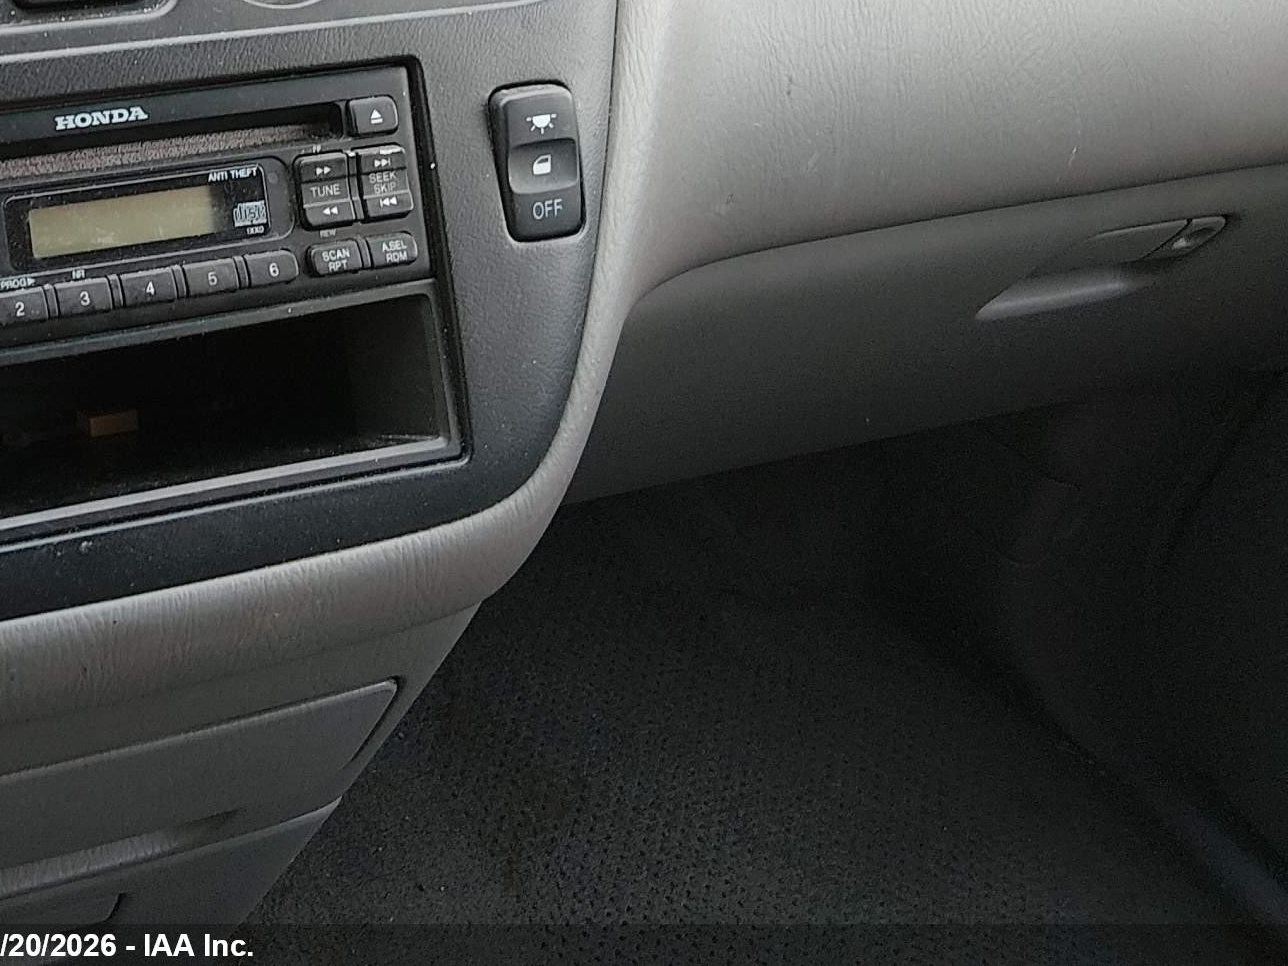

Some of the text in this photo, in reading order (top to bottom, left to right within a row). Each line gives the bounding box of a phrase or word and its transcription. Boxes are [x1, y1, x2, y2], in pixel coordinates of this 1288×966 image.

[54, 106, 149, 131] HONDA
[207, 167, 257, 183] ANTI THEFT
[369, 171, 397, 183] SEEK
[310, 184, 340, 198] TUNE
[374, 183, 396, 194] SKIP
[533, 199, 563, 220] OFF
[322, 248, 350, 262] SCAN
[386, 251, 408, 263] RDM
[269, 263, 279, 277] 6
[328, 260, 348, 272] RPT
[208, 272, 217, 286] 5
[145, 281, 155, 296] 4
[79, 291, 90, 306] 3
[15, 302, 25, 316] 2
